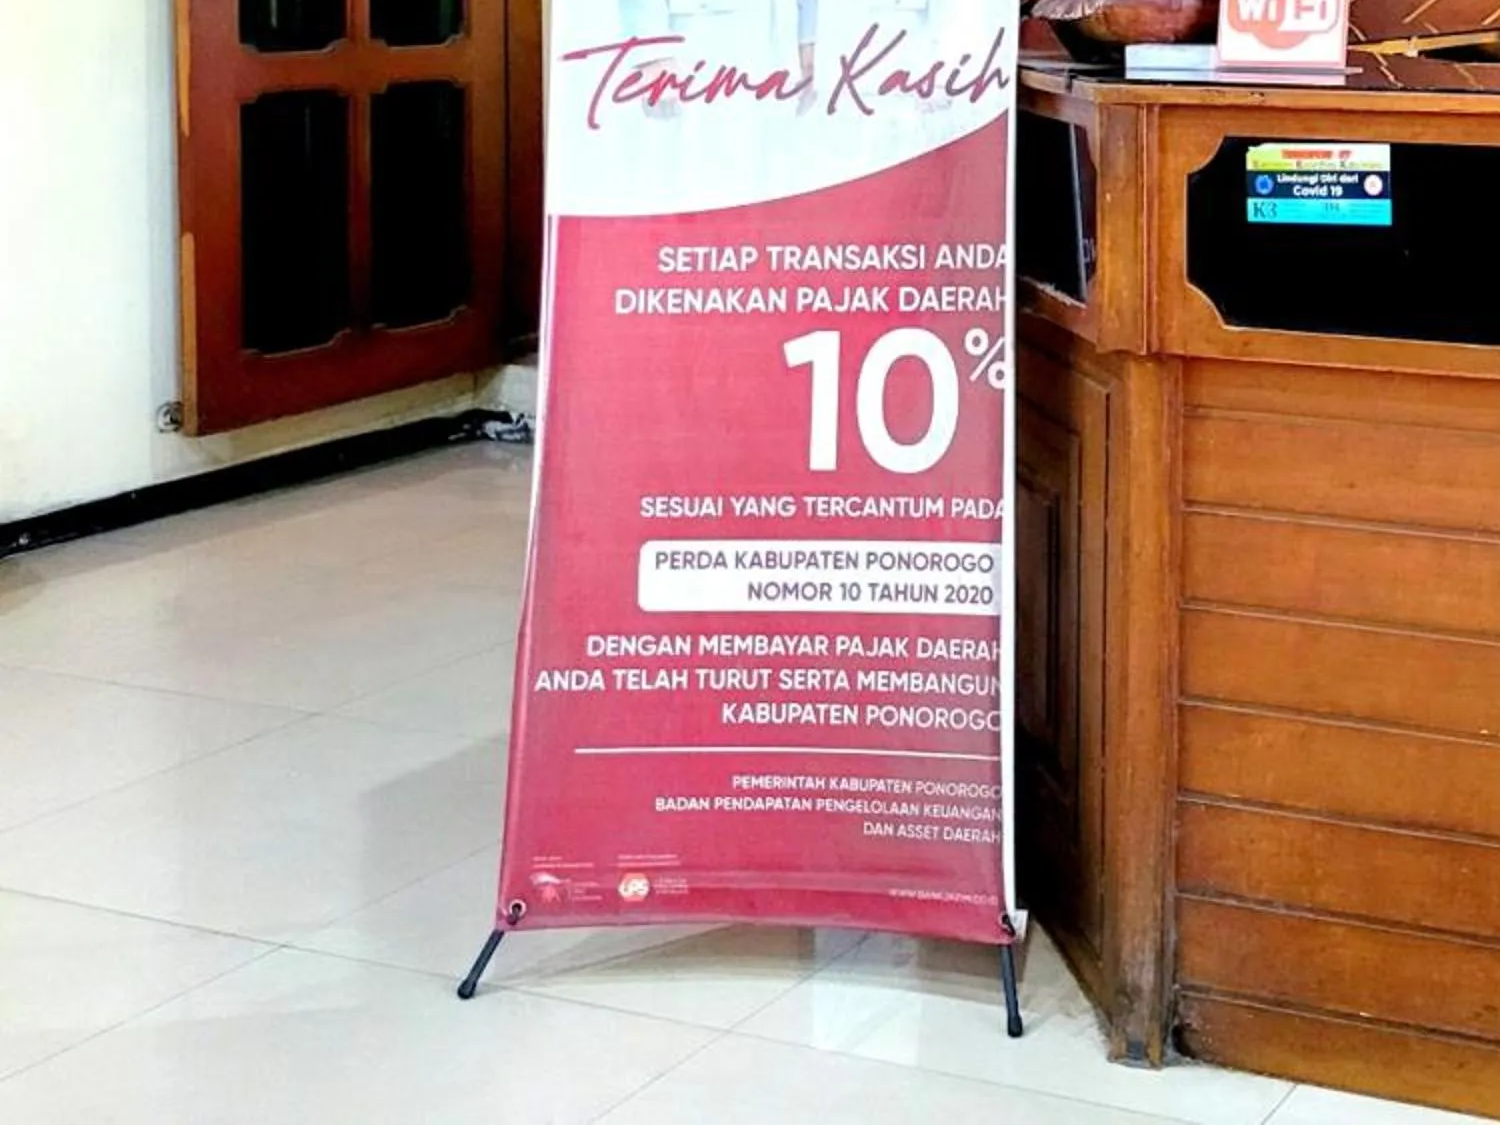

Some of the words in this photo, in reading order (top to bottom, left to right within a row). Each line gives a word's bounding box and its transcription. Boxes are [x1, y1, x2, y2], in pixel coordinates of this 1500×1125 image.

[560, 35, 812, 130] Terima
[826, 22, 1010, 116] Kasih
[1292, 185, 1328, 197] Covid
[1330, 185, 1344, 197] 19
[658, 246, 758, 272] SETIAP
[766, 244, 926, 271] TRANSAKSI
[615, 287, 787, 314] DIKENAKAN
[796, 286, 890, 312] PAJAK
[782, 326, 1008, 475] 10%
[639, 495, 724, 518] SESUAI
[730, 496, 797, 518] YANG
[803, 496, 945, 518] TERCANTUM
[654, 551, 729, 570] PERDA
[734, 550, 860, 571] KABUPATEN
[865, 551, 995, 574] PONOROGO
[747, 581, 833, 602] NOMOR
[839, 581, 862, 602] 10
[867, 582, 939, 603] TAHUN
[944, 584, 994, 605] 2020
[586, 635, 691, 657] DENGAN
[699, 635, 829, 658] MEMBAYAR
[835, 635, 909, 659] PAJAK
[534, 669, 606, 692] ANDA
[612, 668, 688, 691] TELAH
[695, 668, 773, 690] TURUT
[778, 668, 850, 691] SERTA
[721, 702, 858, 725] KABUPATEN
[731, 775, 826, 790] PEMERINTAH
[829, 777, 912, 794] KABUPATEN
[655, 797, 711, 812] BADAN
[714, 796, 813, 812] PENDAPATAN
[815, 798, 919, 817] PENGELOLAAN
[863, 822, 894, 837] DAN
[896, 824, 939, 841] ASSET
[943, 826, 1001, 844] DAERAH
